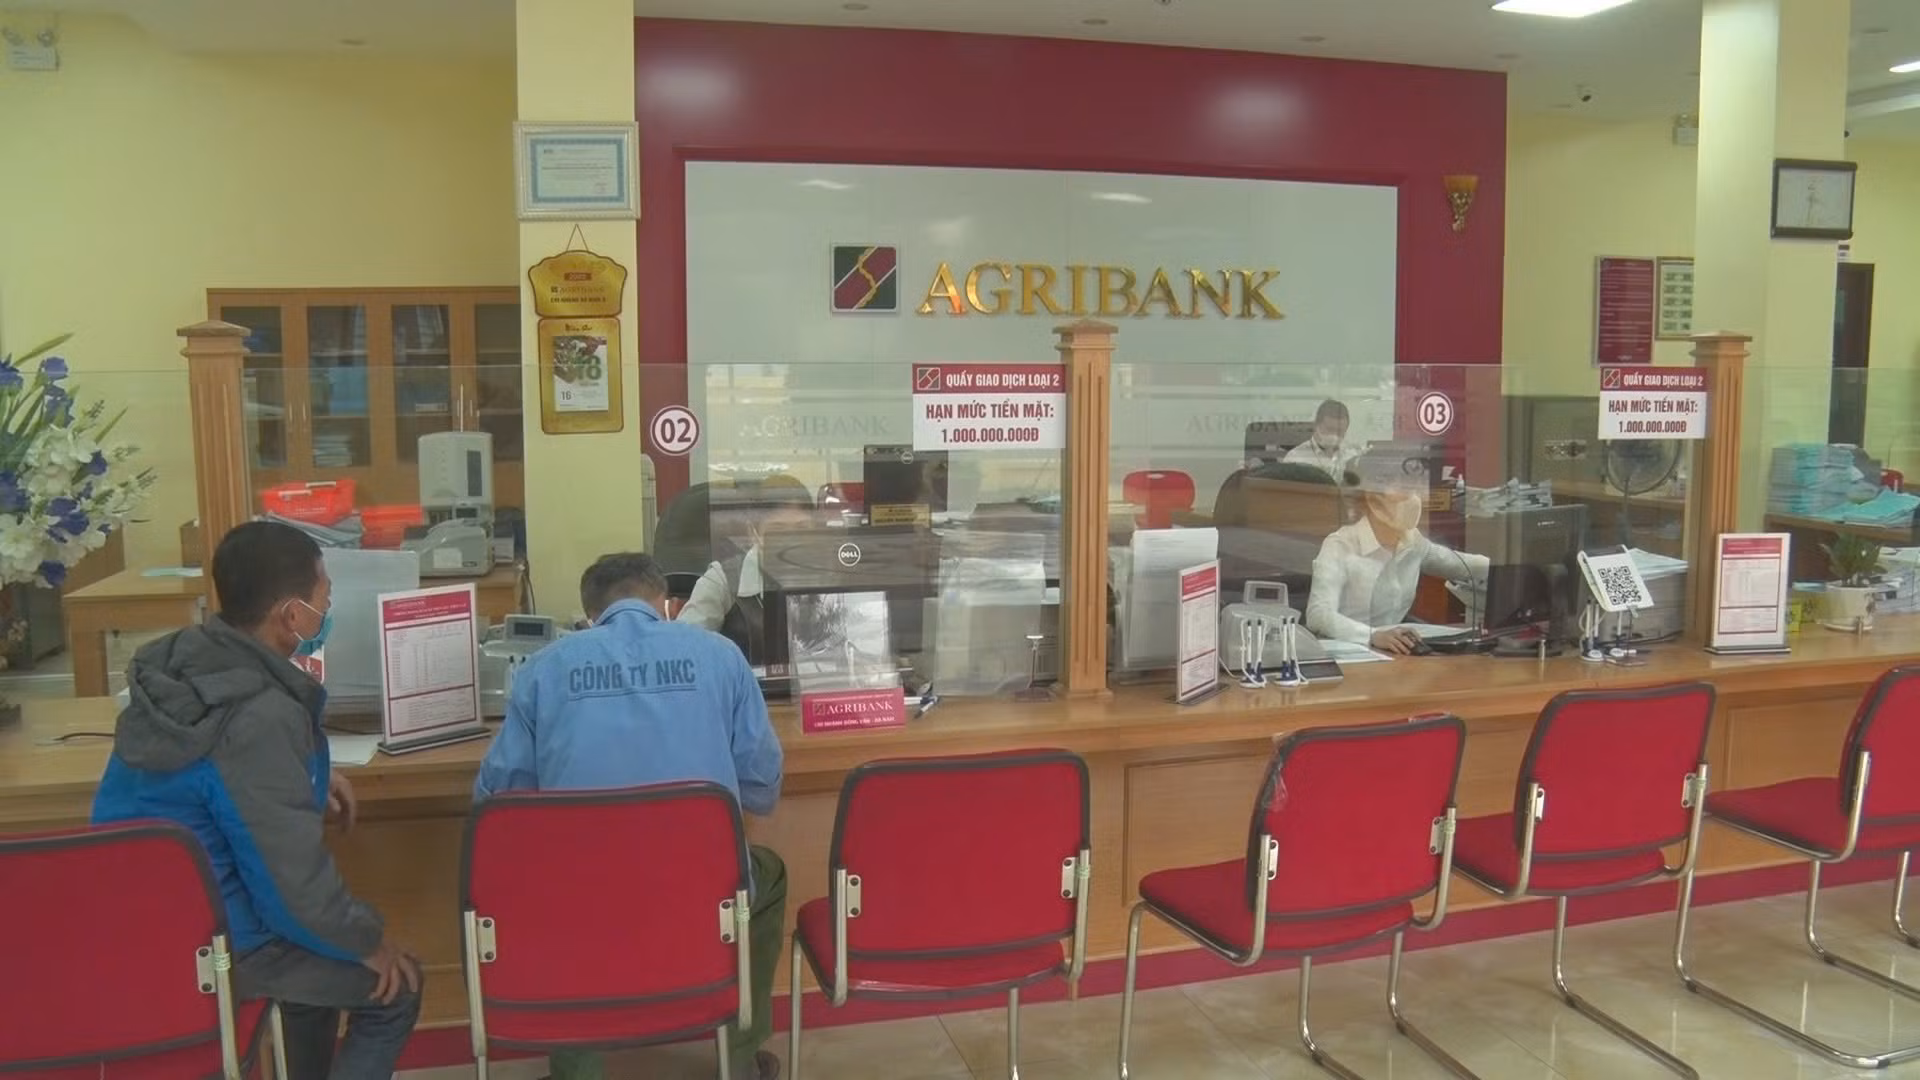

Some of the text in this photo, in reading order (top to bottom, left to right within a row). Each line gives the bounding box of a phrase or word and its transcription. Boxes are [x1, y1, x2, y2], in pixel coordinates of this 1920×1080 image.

[915, 261, 1285, 320] AGRIBANK
[975, 373, 999, 386] GIAO
[1002, 373, 1026, 388] DỊCH
[1028, 373, 1050, 389] LOẠI
[1052, 374, 1060, 386] 2
[1644, 374, 1662, 386] GIAO
[1663, 375, 1680, 388] DỊCH
[1680, 375, 1697, 388] LOẠI
[1697, 376, 1704, 386] 2
[926, 403, 953, 422] HẠN
[957, 400, 987, 419] MỨC
[1023, 401, 1054, 421] MẶT:
[1424, 402, 1446, 425] 03
[1608, 400, 1628, 415] HẠN
[1630, 396, 1652, 413] MỨC
[660, 417, 692, 444] 02
[569, 659, 696, 694] CÔNG TY NKC
[826, 700, 894, 715] AGRIBANK
